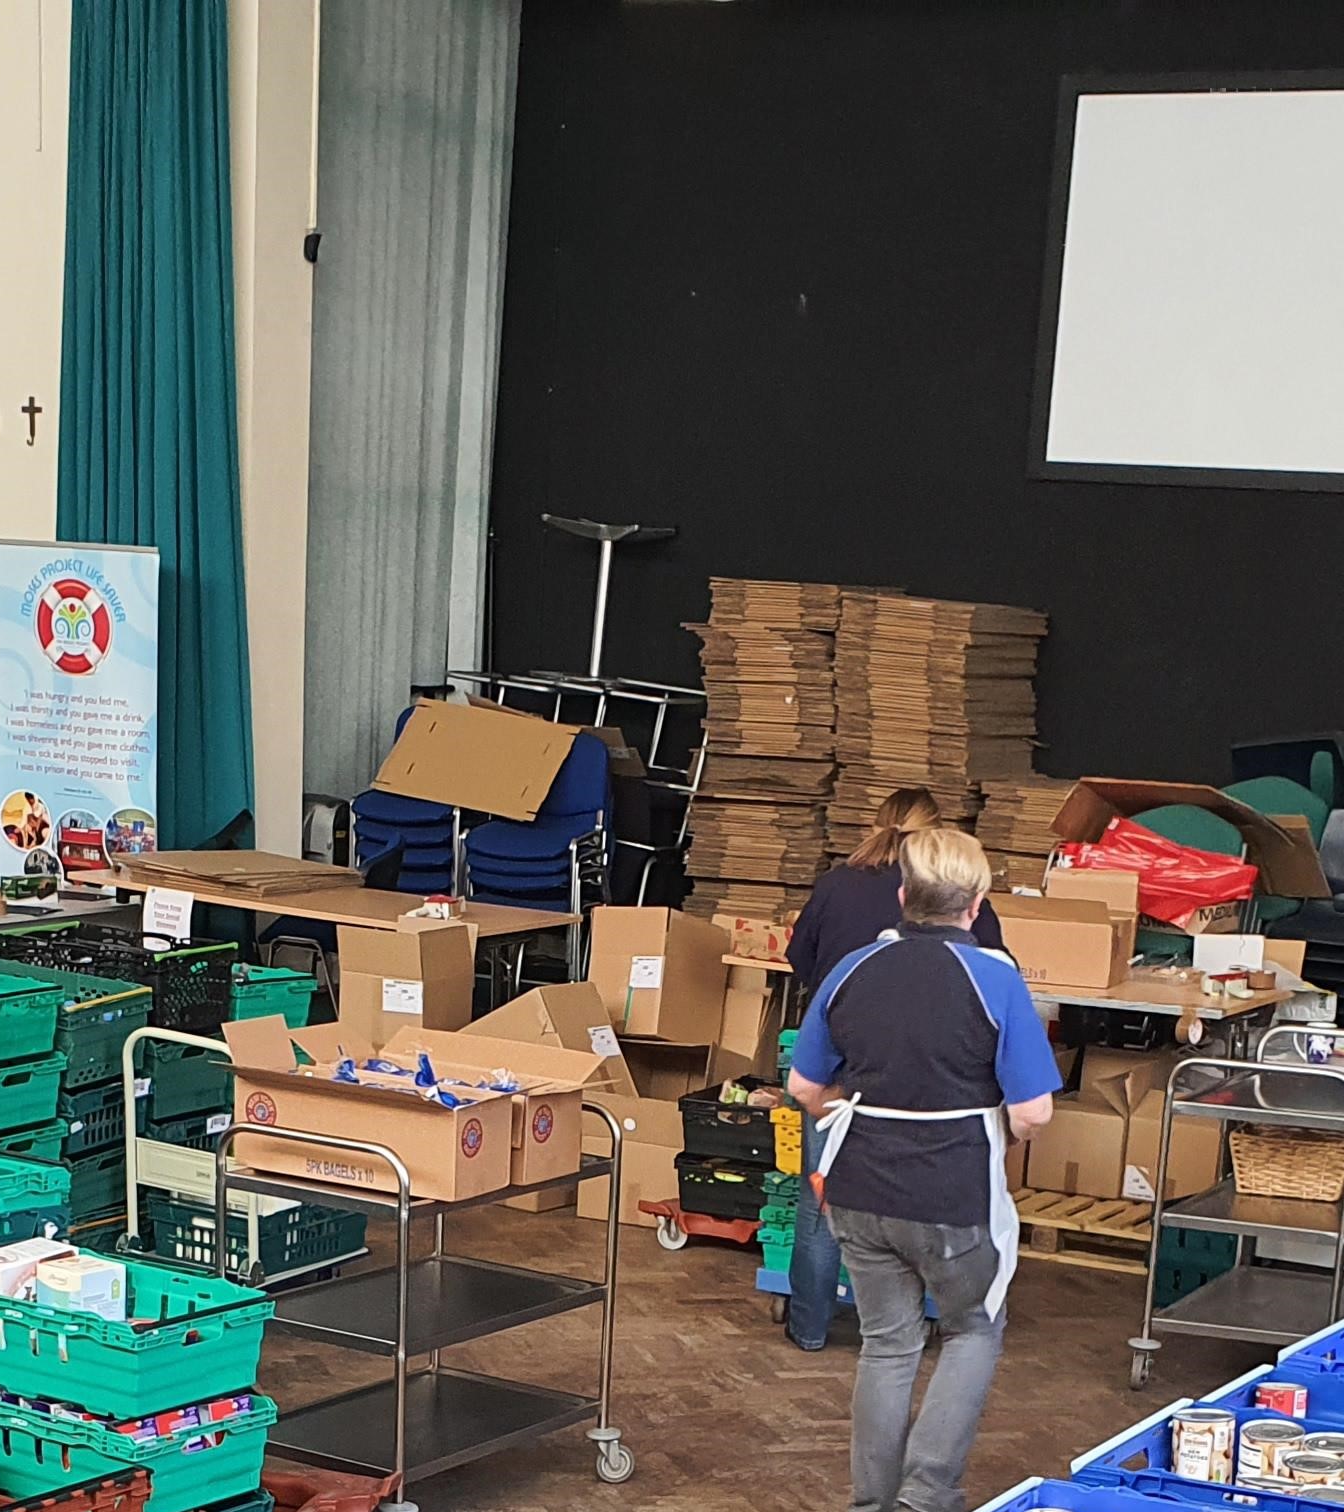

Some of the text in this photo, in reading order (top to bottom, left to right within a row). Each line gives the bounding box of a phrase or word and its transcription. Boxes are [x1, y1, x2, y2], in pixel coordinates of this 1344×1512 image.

[21, 558, 127, 623] MOSES PROJECT LIFE SAVER
[45, 691, 68, 704] hungry
[71, 694, 83, 703] and
[84, 696, 97, 706] you
[56, 709, 68, 717] and
[70, 711, 81, 719] you
[83, 713, 98, 721] gave
[26, 719, 58, 730] homeless
[60, 723, 72, 731] and
[73, 725, 85, 733] you
[87, 727, 103, 736] gave
[28, 734, 58, 746] shivering
[60, 738, 72, 746] and
[73, 741, 85, 749] you
[87, 742, 103, 751] gave
[53, 753, 65, 761] and
[67, 755, 79, 763] you
[81, 756, 107, 766] stopped
[44, 766, 64, 775] prison
[66, 767, 78, 776] and
[80, 770, 92, 778] you
[94, 772, 112, 780] came
[306, 1158, 374, 1183] 5PK BAGELS x 10
